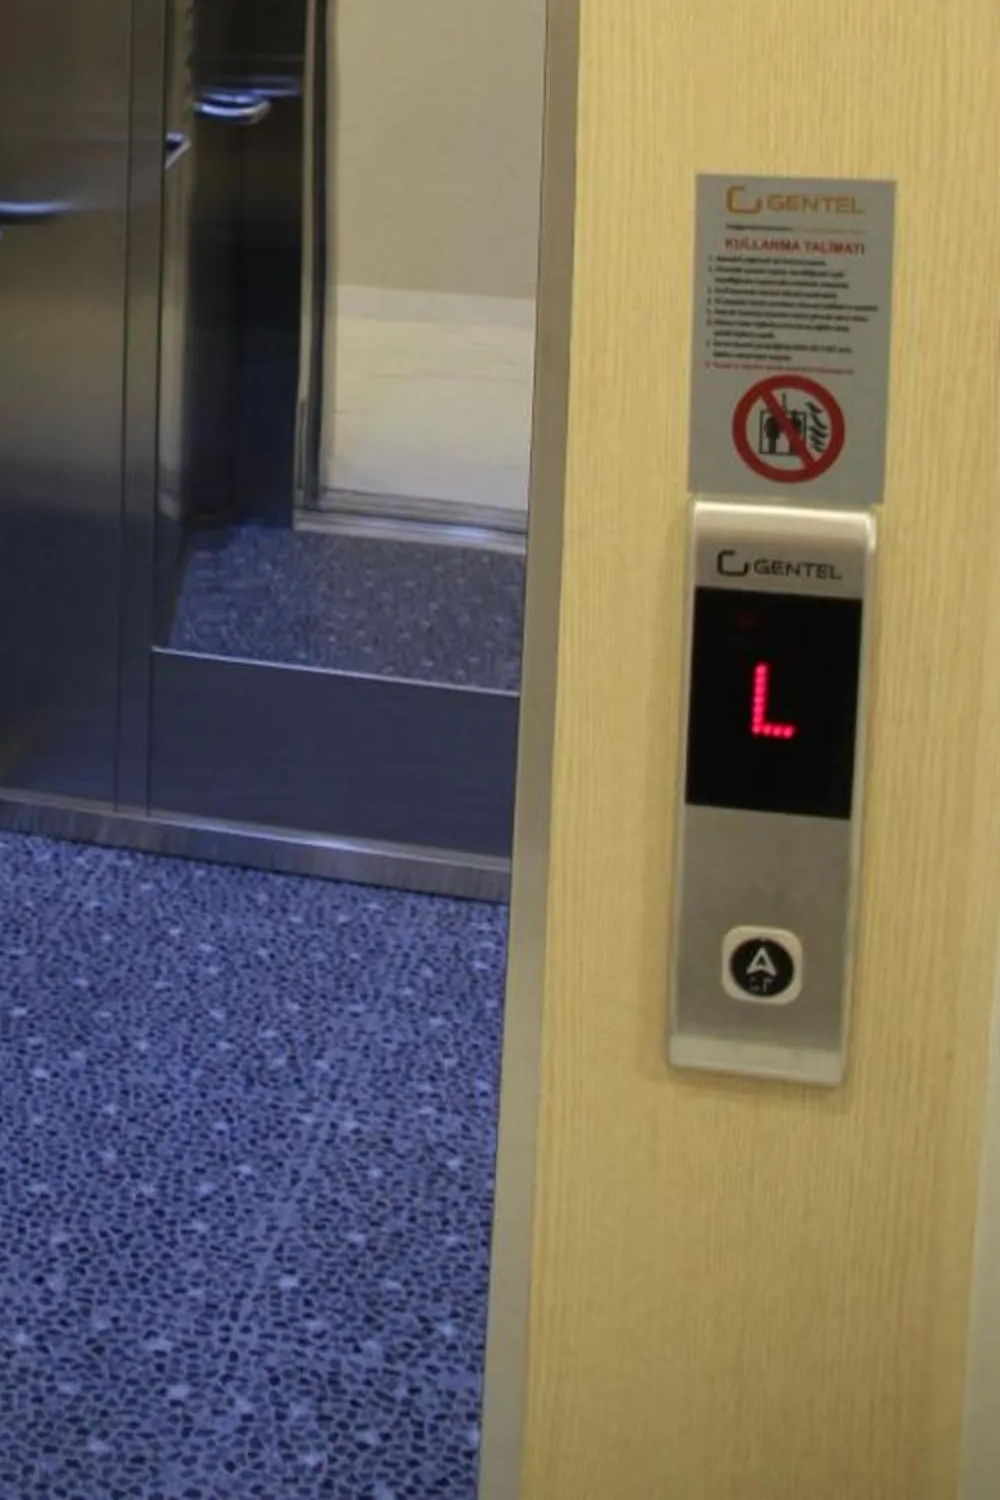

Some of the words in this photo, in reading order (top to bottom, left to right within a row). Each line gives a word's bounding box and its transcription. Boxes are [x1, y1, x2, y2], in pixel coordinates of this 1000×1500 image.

[766, 194, 864, 214] GENTEL
[753, 558, 842, 580] GENTEL
[750, 662, 795, 739] L
